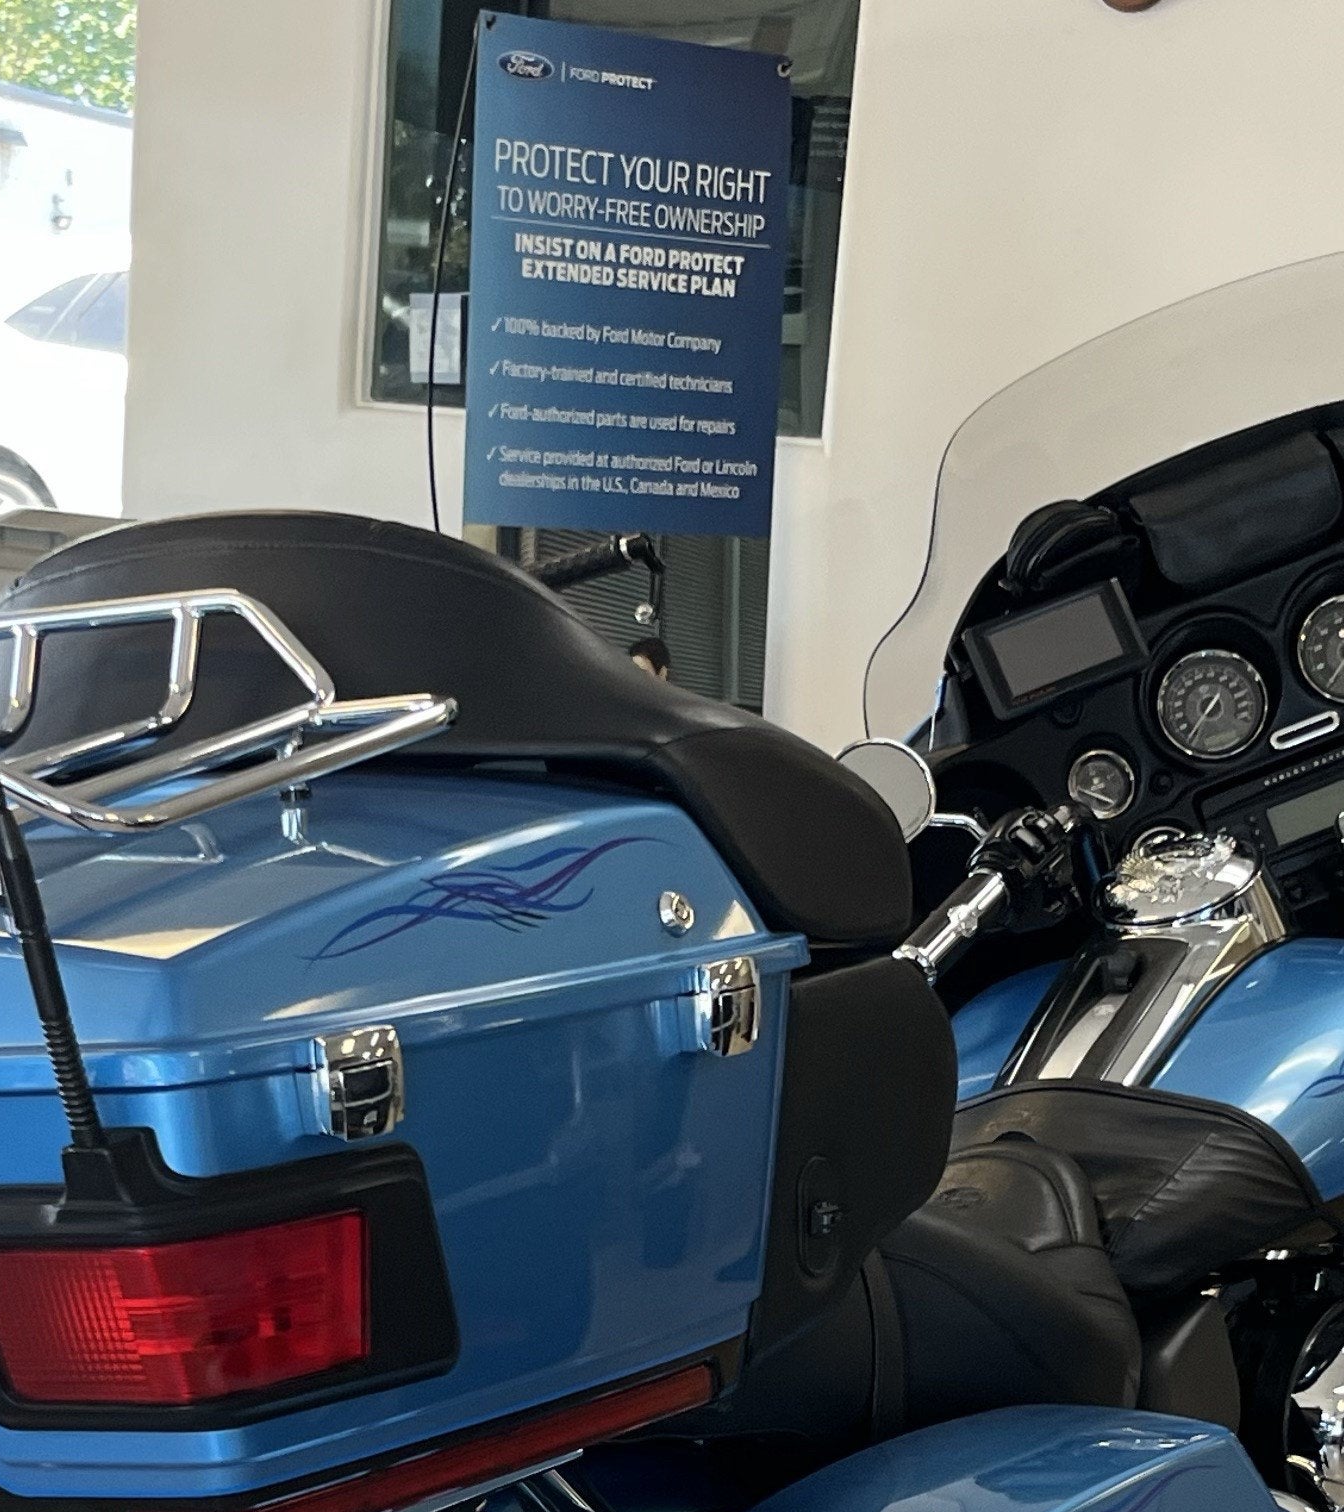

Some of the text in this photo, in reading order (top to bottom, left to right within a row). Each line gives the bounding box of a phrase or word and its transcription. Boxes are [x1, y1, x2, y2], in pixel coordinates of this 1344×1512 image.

[507, 56, 543, 77] Ford
[570, 67, 654, 90] FORD PROTECT
[495, 138, 770, 203] PROTECT YOUR RIGHT
[498, 185, 765, 238] TO WORRY-FREE OWNERSHIP
[516, 233, 744, 275] INSIST ON A FORD PROTECT
[522, 260, 735, 296] EXTENDED SERVICE PLAN
[504, 317, 721, 355] 100% backed by Ford Motor Company
[502, 361, 733, 394] Factory-trained and certified technicians
[500, 403, 735, 437] Ford-authorized parts are used for repairs
[499, 445, 757, 476] Service provided at authorized Ford or Lincoln
[499, 472, 565, 491] dealerships
[567, 475, 578, 490] in
[580, 476, 600, 491] the
[629, 478, 672, 497] Canada
[674, 481, 699, 498] and
[701, 482, 739, 500] Mexico
